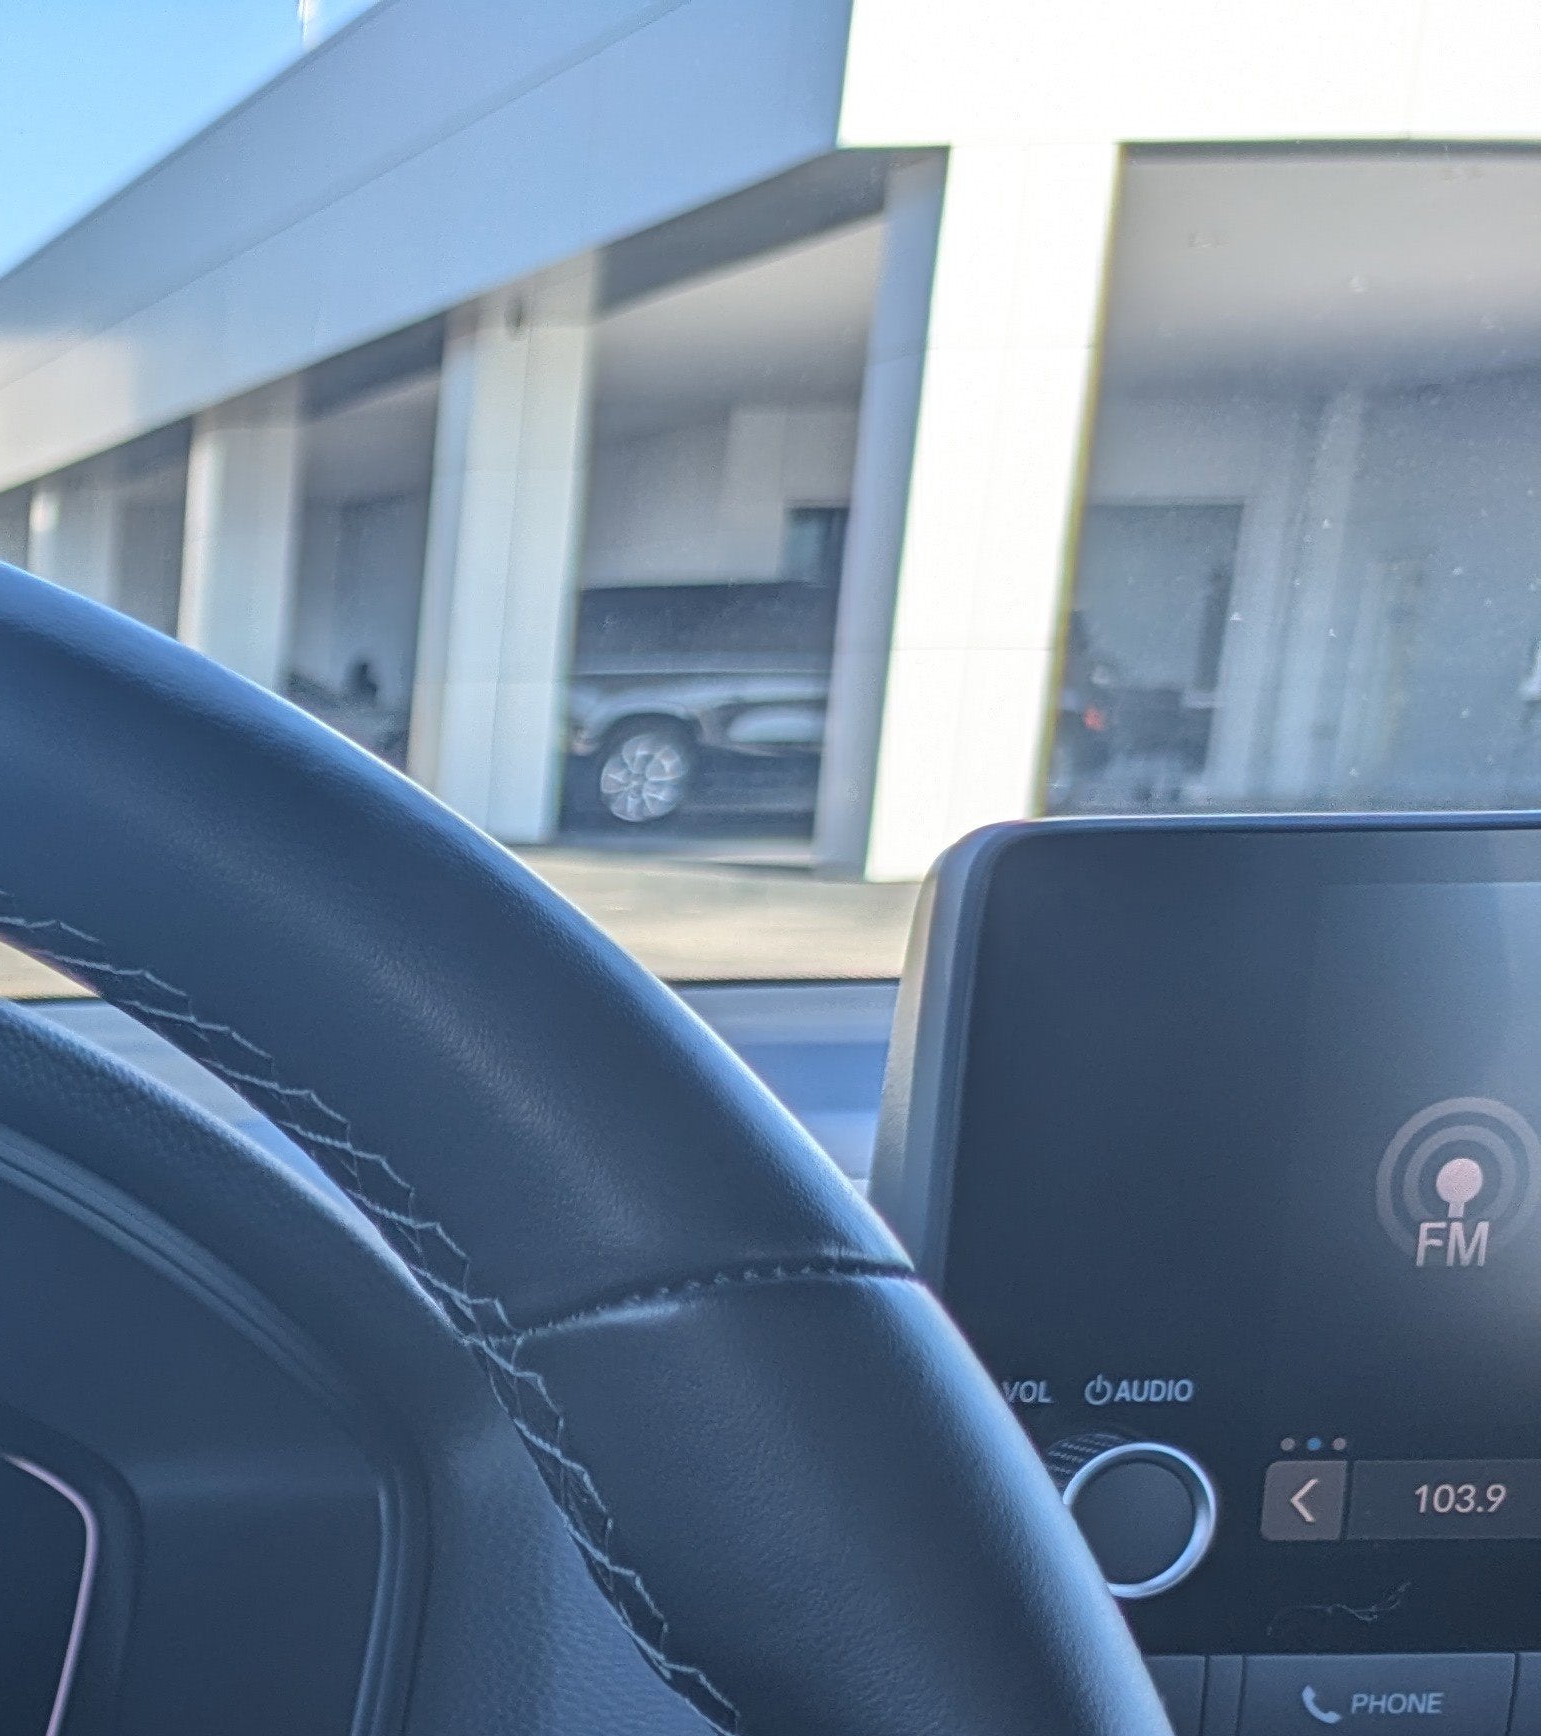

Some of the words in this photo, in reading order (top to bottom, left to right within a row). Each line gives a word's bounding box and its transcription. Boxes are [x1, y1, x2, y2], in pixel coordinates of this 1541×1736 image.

[1416, 1220, 1491, 1268] FM
[999, 1380, 1055, 1404] VOL
[1114, 1379, 1194, 1403] AUDIO
[1414, 1483, 1507, 1514] 103.9
[1350, 1692, 1445, 1716] PHONE
